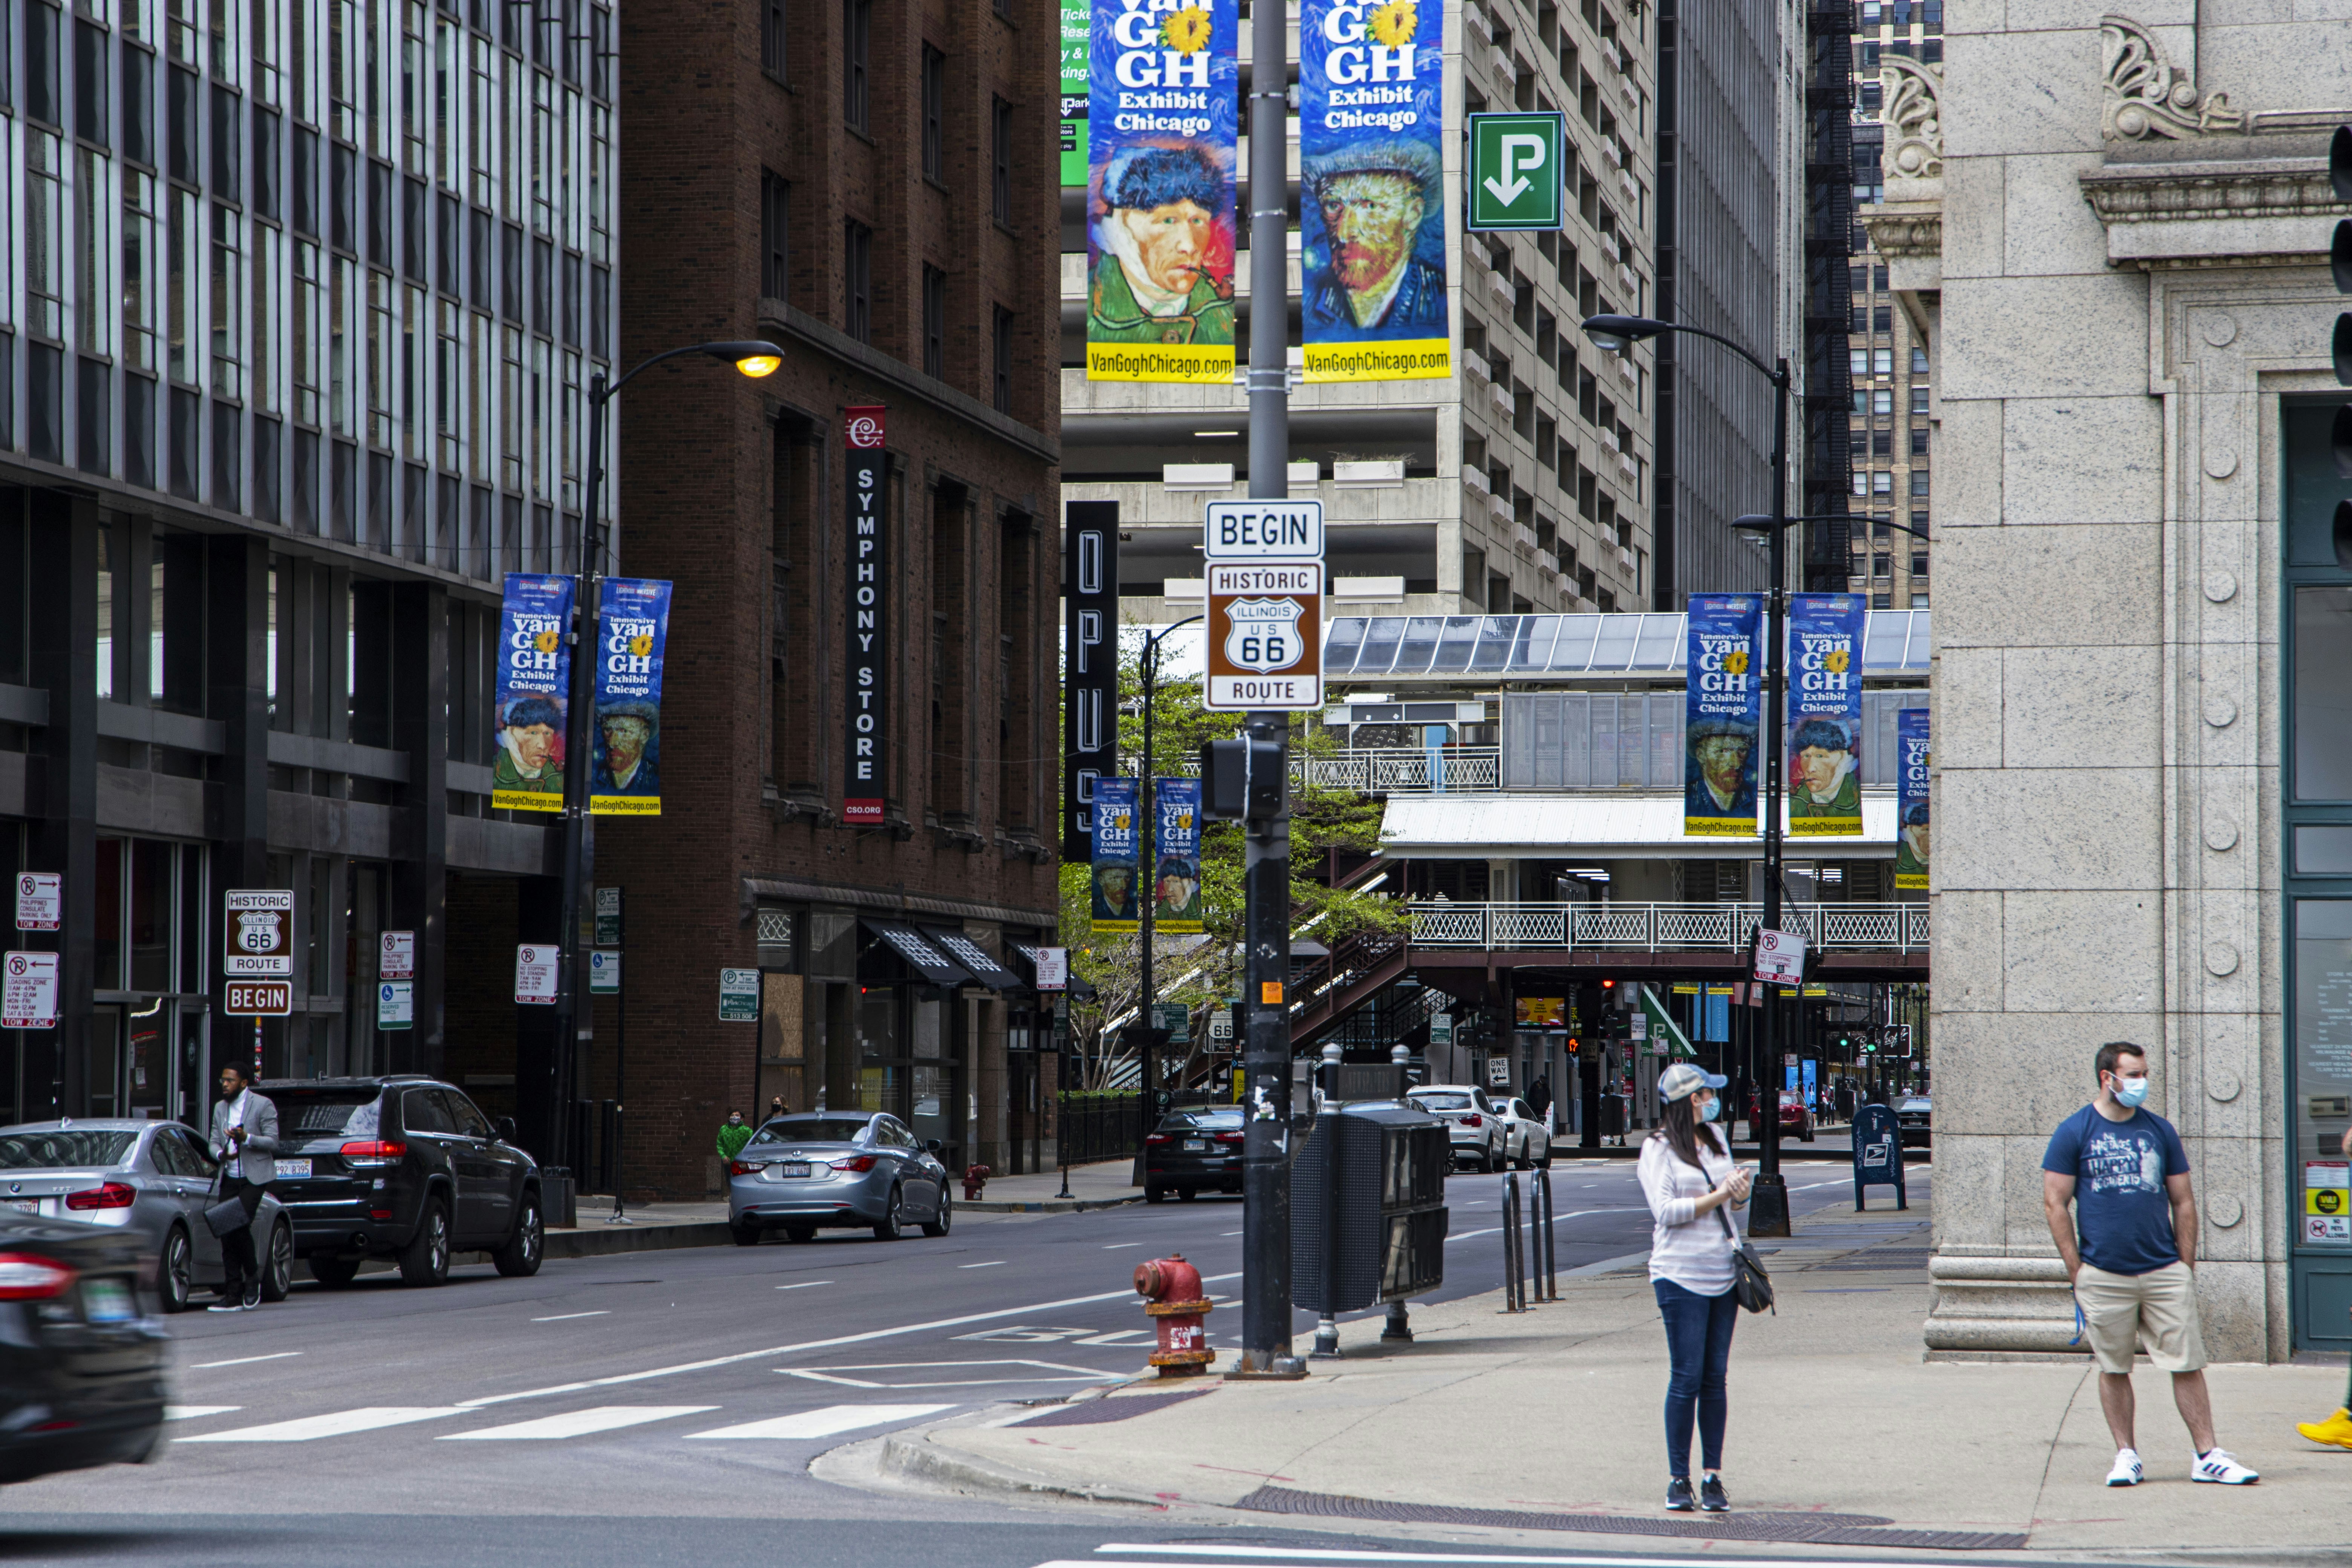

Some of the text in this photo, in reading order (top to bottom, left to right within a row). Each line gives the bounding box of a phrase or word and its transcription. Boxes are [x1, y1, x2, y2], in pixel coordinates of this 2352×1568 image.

[1073, 48, 1083, 59] &
[1115, 51, 1211, 87] GH
[1325, 44, 1417, 84] GH
[1119, 92, 1207, 109] Exhibit
[1329, 85, 1413, 106] Exhibit
[1114, 114, 1211, 137] Chicago
[1325, 109, 1417, 132] Chicago
[1092, 353, 1232, 378] VanGoghChicago.com
[1308, 351, 1448, 375] VanGoghChicago.com
[1221, 514, 1307, 545] BEGIN
[858, 469, 874, 652] SYMPHONY
[1220, 572, 1308, 589] HISTORIC
[513, 612, 561, 620] Immersive
[1237, 606, 1290, 617] ILLINOIS
[1242, 637, 1284, 663] 66
[511, 651, 558, 670] GH
[608, 655, 651, 673] GH
[512, 670, 555, 681] Exhibit
[609, 675, 648, 684] Exhibit
[1700, 672, 1748, 692] GH
[1801, 672, 1848, 690] GH
[509, 681, 556, 693] Chicago
[606, 685, 649, 697] Chicago
[1233, 682, 1294, 698] ROUTE
[1701, 694, 1746, 702] Exhibit
[1699, 704, 1747, 716] Chicago
[1801, 703, 1848, 714] Chicago
[856, 666, 874, 779] STORE
[495, 794, 562, 808] VanGoghChicago.com
[592, 800, 659, 811] VanGoghChicago.com
[1100, 828, 1130, 840] GH
[1164, 828, 1192, 840] GH
[1686, 822, 1756, 835] VanGoghChicago.com
[1790, 822, 1862, 834] VanGoghChicago.com
[230, 896, 289, 906] HISTORIC
[247, 934, 271, 948] 66
[237, 959, 280, 969] ROUTE
[231, 989, 284, 1008] BEGIN
[1214, 1025, 1231, 1036] 66
[292, 1165, 309, 1174] 8395
